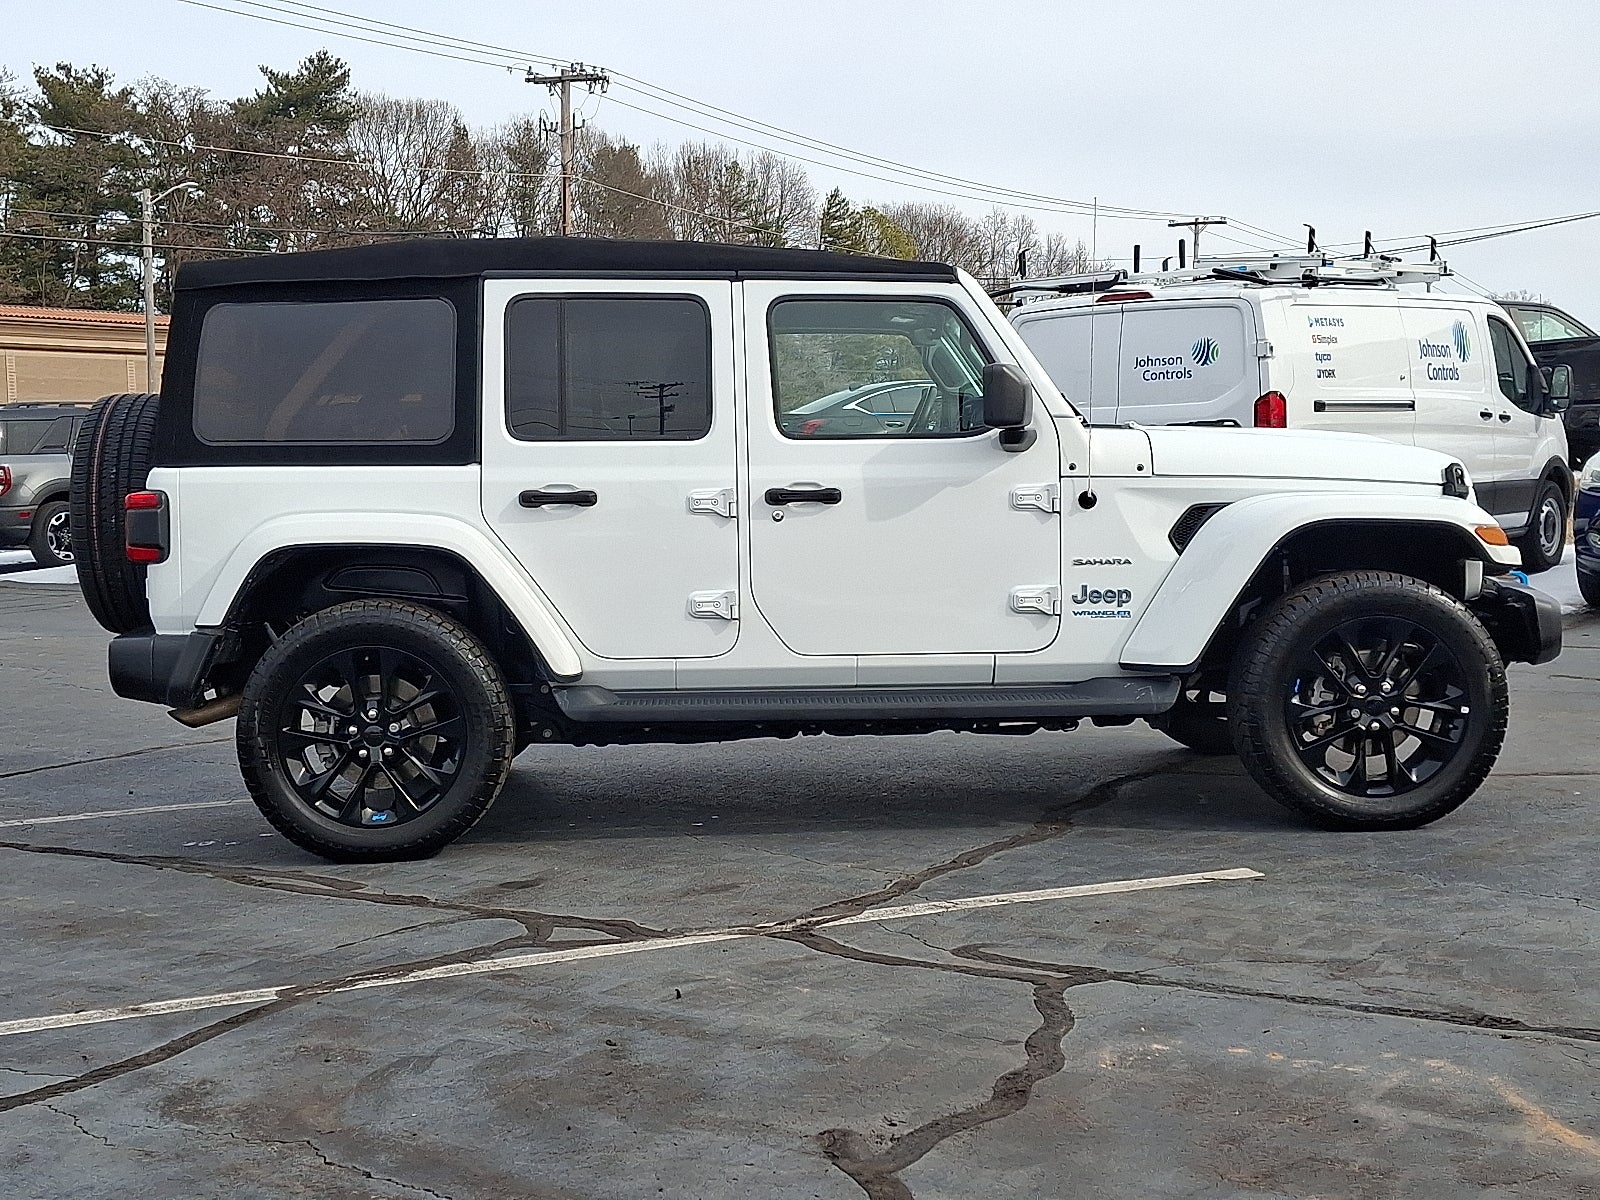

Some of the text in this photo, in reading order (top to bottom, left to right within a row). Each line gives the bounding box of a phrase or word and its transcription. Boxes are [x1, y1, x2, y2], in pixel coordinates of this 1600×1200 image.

[1314, 317, 1345, 327] METASYS
[1418, 338, 1452, 359] Johnson
[1134, 355, 1183, 370] Johnson
[1315, 352, 1332, 364] tyco
[1142, 366, 1193, 381] Controls
[1427, 362, 1460, 381] Controls
[1072, 558, 1133, 566] SAHARA
[1071, 584, 1132, 608] Jeep
